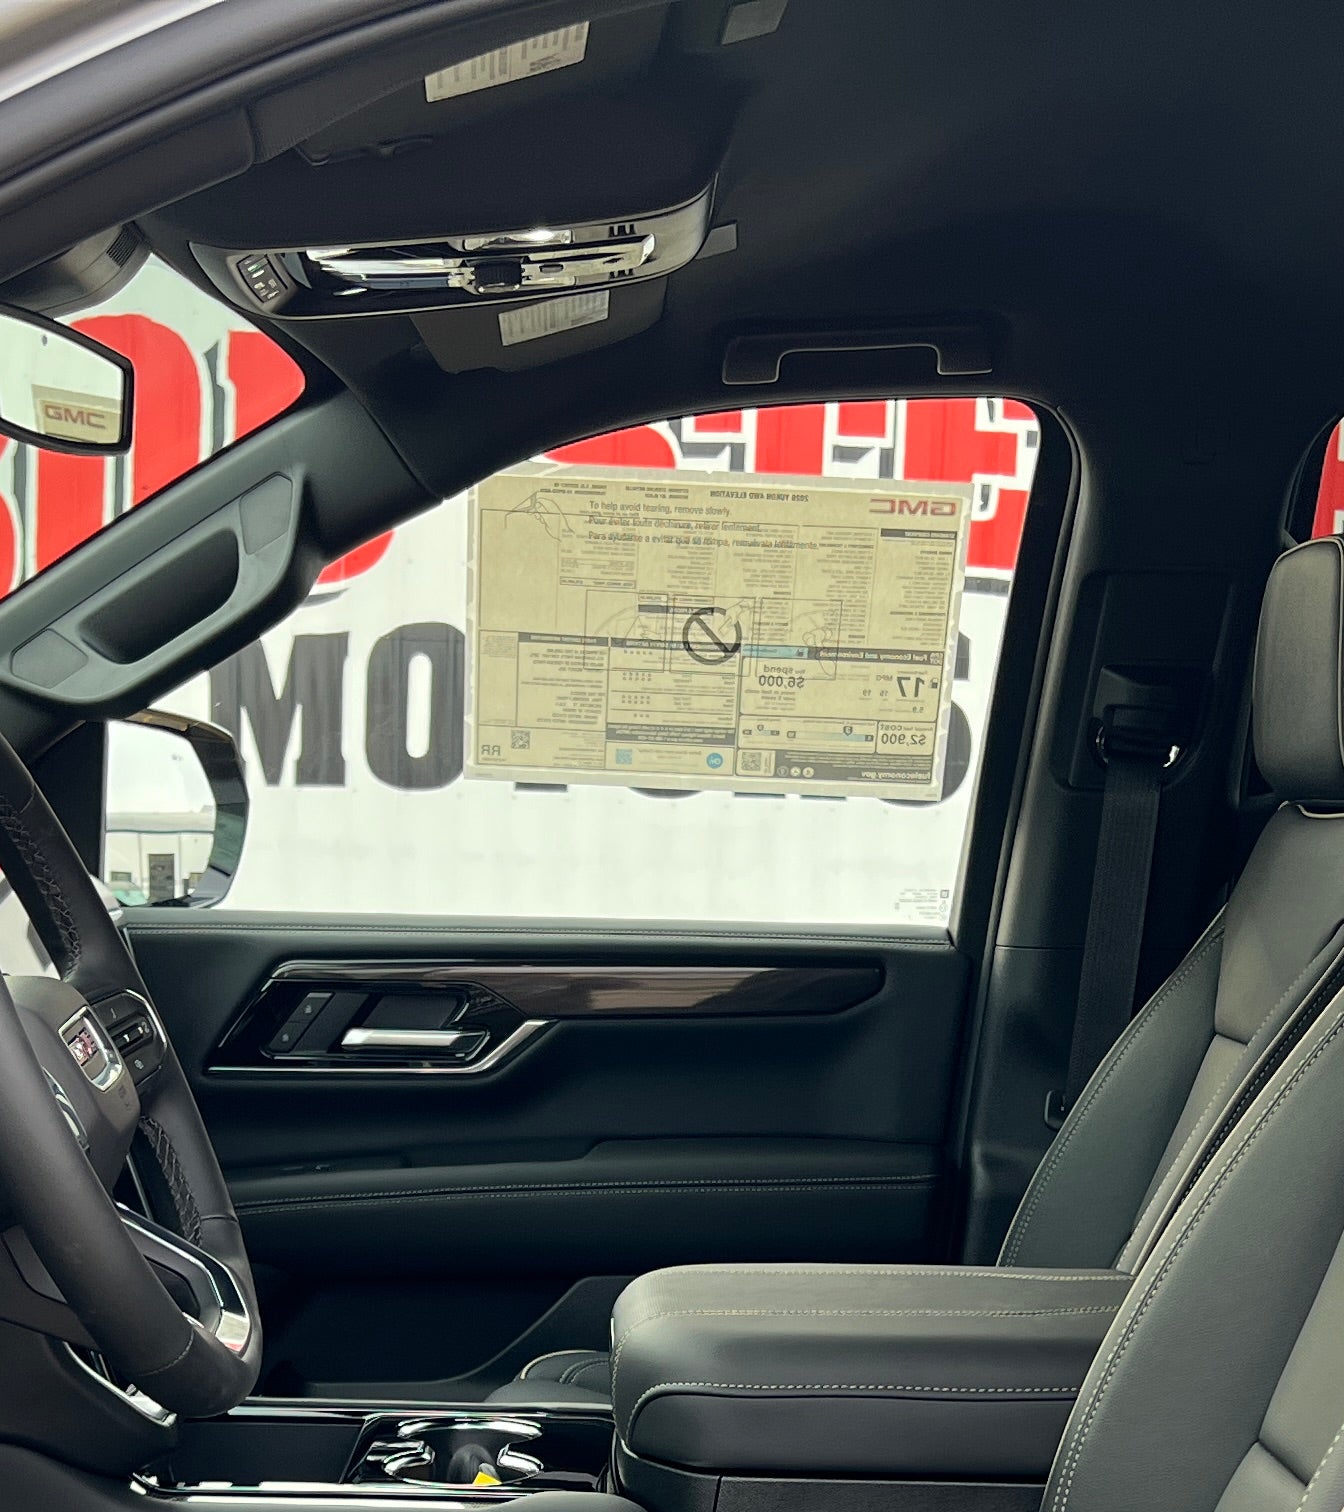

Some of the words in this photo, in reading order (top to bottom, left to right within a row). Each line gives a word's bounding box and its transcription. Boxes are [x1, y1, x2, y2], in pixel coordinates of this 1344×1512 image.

[44, 404, 106, 430] GMC
[589, 501, 599, 509] To
[600, 502, 618, 512] help
[619, 503, 641, 512] avoid
[674, 506, 704, 515] remove
